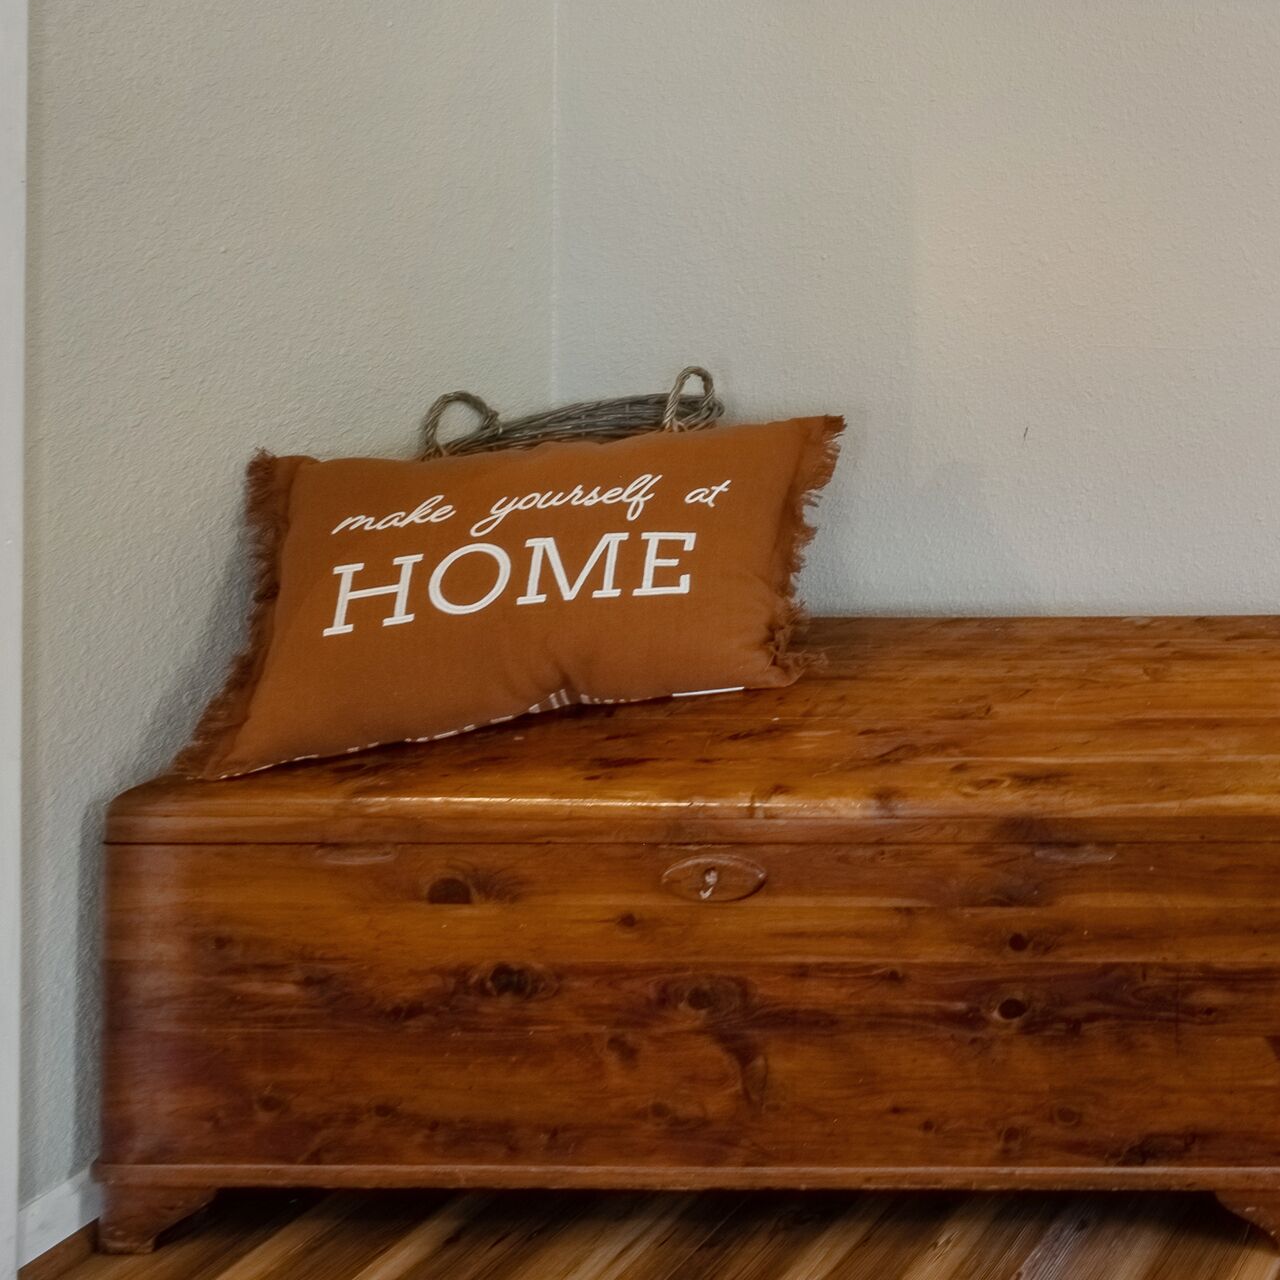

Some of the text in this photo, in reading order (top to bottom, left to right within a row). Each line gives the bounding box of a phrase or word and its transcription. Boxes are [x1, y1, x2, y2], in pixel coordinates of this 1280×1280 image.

[331, 474, 731, 537] make yourself at
[322, 530, 698, 638] HOME
